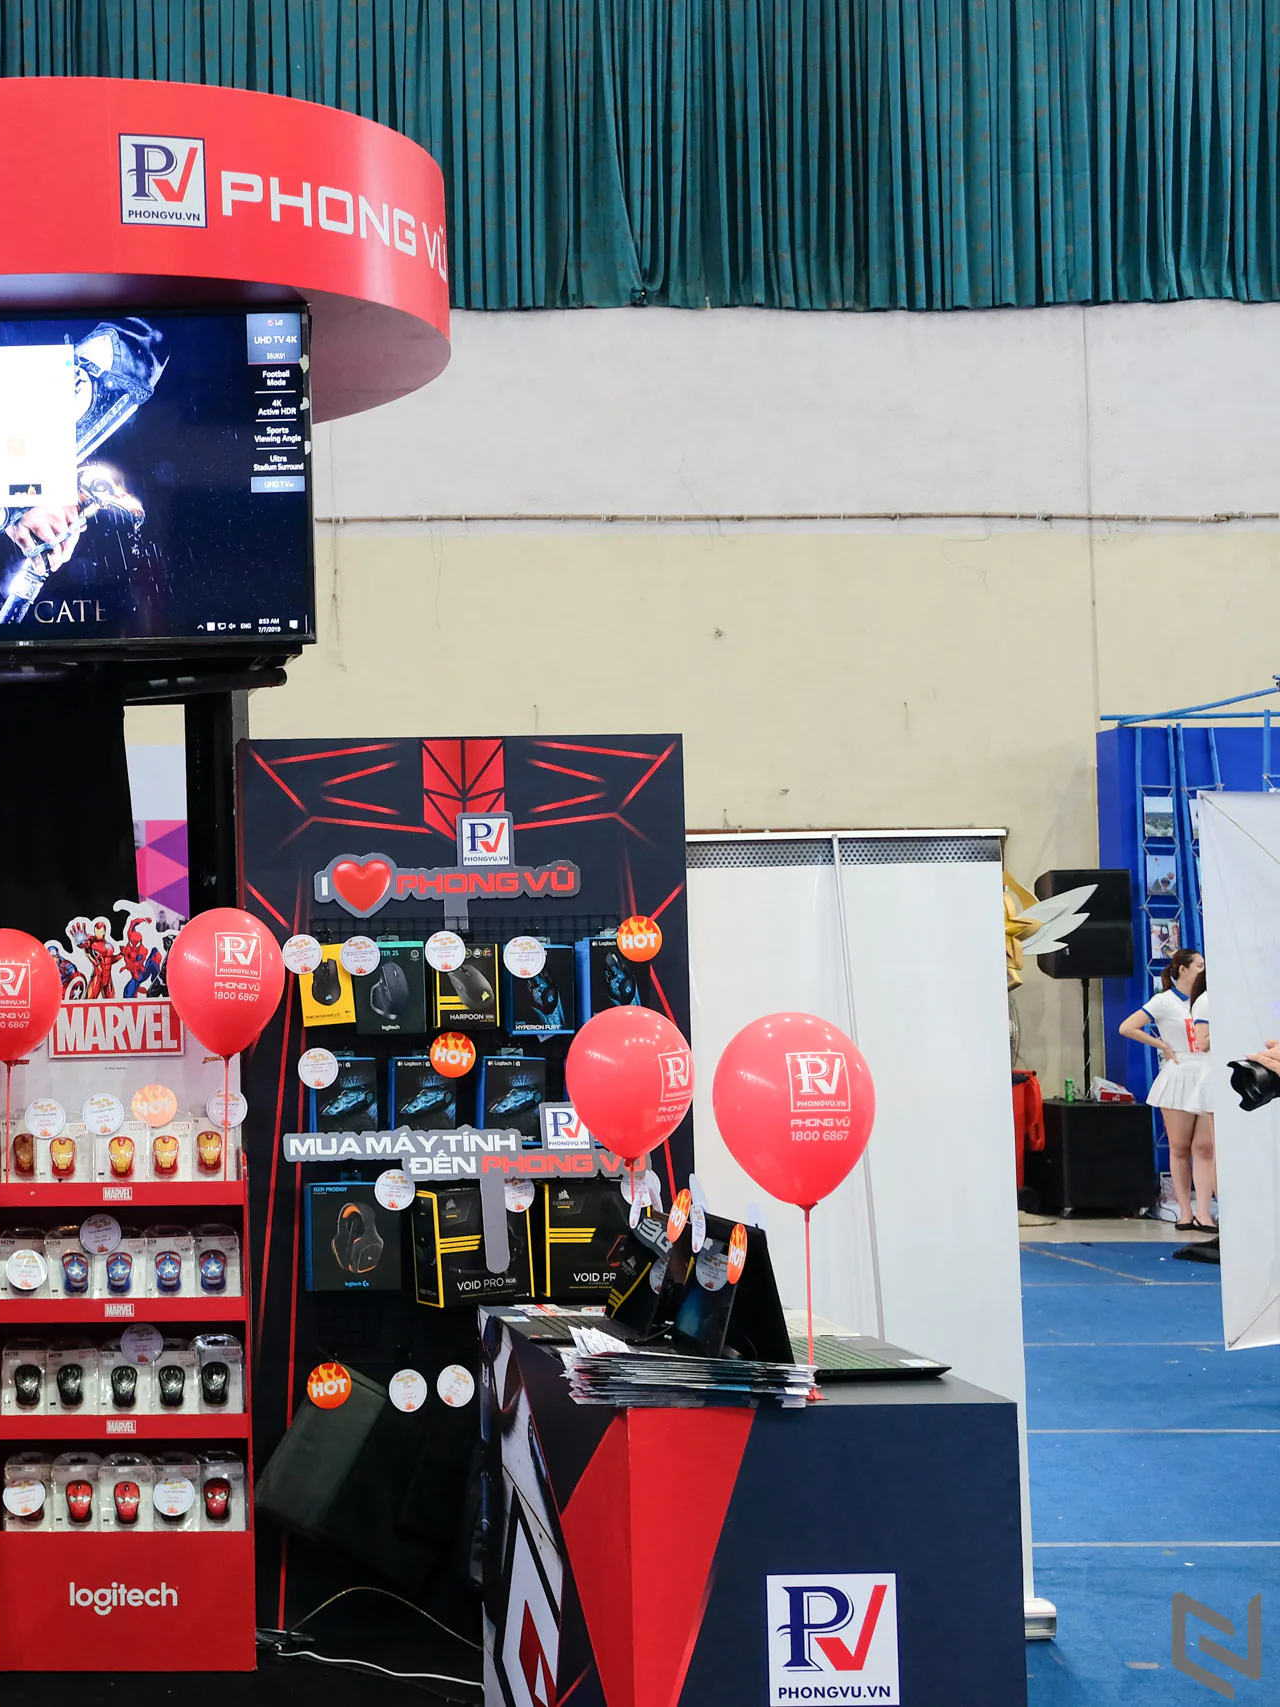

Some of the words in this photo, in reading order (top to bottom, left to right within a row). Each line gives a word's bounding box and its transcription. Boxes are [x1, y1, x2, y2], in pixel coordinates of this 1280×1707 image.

[128, 209, 200, 222] PHONGVU.VN
[221, 170, 416, 257] PHONG
[422, 224, 447, 284] VŨ
[254, 336, 272, 344] UHD
[273, 336, 285, 344] TV
[286, 335, 297, 343] 4K
[262, 370, 290, 378] Football
[267, 378, 286, 386] Mode
[258, 408, 280, 416] Active
[281, 407, 296, 415] HDR
[266, 426, 289, 435] Sports
[254, 435, 281, 444] Viewing
[281, 434, 301, 443] Angle
[270, 455, 287, 463] Ultra
[253, 464, 277, 472] Stadium
[277, 463, 304, 471] Surround
[464, 855, 510, 863] PHONGVU.VN
[396, 871, 519, 894] PHONG
[523, 866, 576, 891] VŨ
[622, 933, 657, 950] HOT
[220, 968, 258, 976] PHONGVU.VN
[214, 982, 247, 990] PHONG
[214, 991, 236, 1000] 1800
[238, 993, 259, 1002] 6867
[57, 1003, 179, 1052] MARVEL
[434, 1046, 472, 1067] HOT
[136, 1099, 172, 1115] HOT
[791, 1119, 834, 1128] PHONG
[836, 1116, 851, 1127] VŨ
[290, 1134, 365, 1157] MUA
[366, 1126, 443, 1155] MÁY
[444, 1125, 517, 1151] TÍNH
[791, 1131, 820, 1141] 1800
[822, 1131, 849, 1141] 6867
[409, 1149, 476, 1175] ĐẾN
[482, 1155, 594, 1173] PHONG
[104, 1188, 131, 1200] MARVEL
[671, 1206, 686, 1230] HOT
[728, 1250, 744, 1268] HOT
[573, 1272, 600, 1282] VOID
[457, 1280, 481, 1291] VOID
[483, 1277, 504, 1288] PRO
[106, 1304, 134, 1317] MARVEL
[311, 1379, 347, 1398] HOT
[107, 1420, 135, 1433] MARVEL
[70, 1582, 178, 1615] logitech
[778, 1685, 891, 1699] PHONGVU.VN
